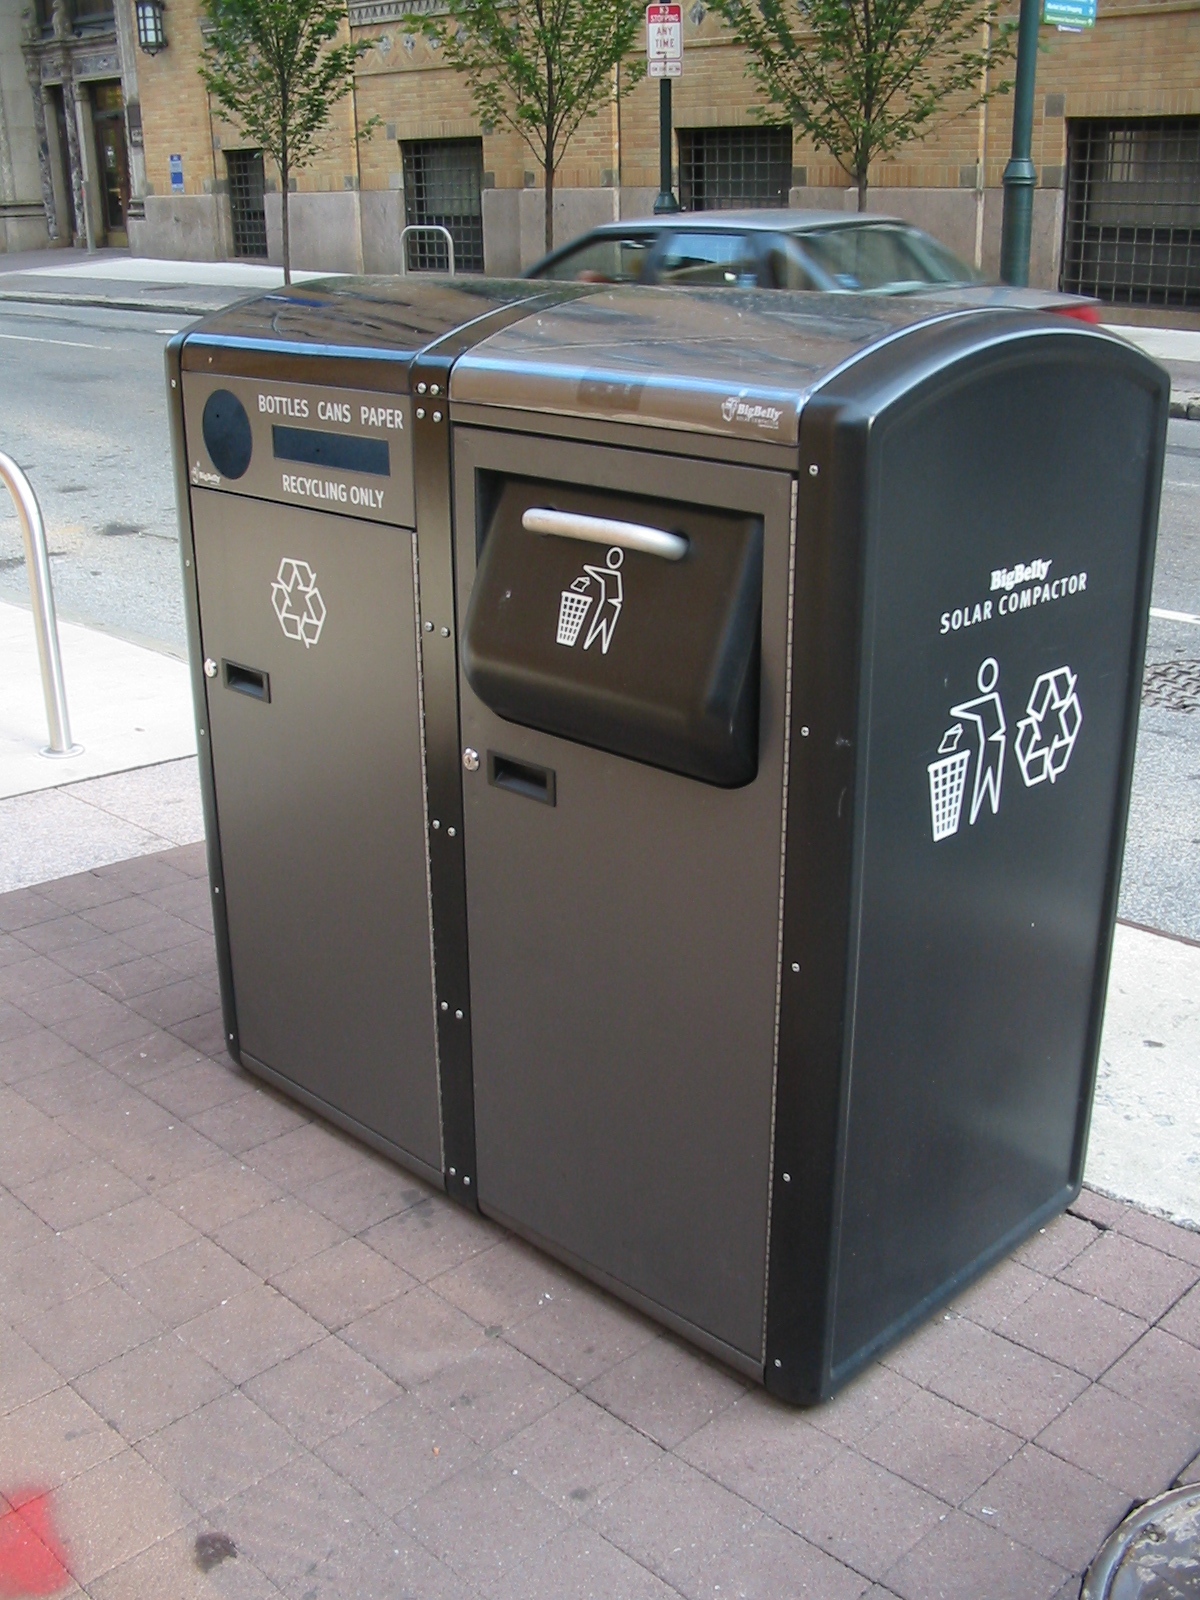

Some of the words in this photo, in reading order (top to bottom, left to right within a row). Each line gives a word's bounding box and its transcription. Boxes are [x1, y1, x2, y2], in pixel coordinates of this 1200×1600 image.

[655, 39, 674, 48] TIME
[657, 26, 673, 35] ANY
[258, 394, 309, 418] BOTTLES
[317, 401, 351, 423] CANS
[360, 406, 403, 429] PAPER
[737, 403, 783, 421] BigBelly
[282, 474, 347, 502] RECYCLING
[350, 485, 384, 508] ONLY
[990, 558, 1052, 591] BigBelly
[940, 600, 993, 634] SOLAR
[998, 572, 1088, 616] COMPACTOR
